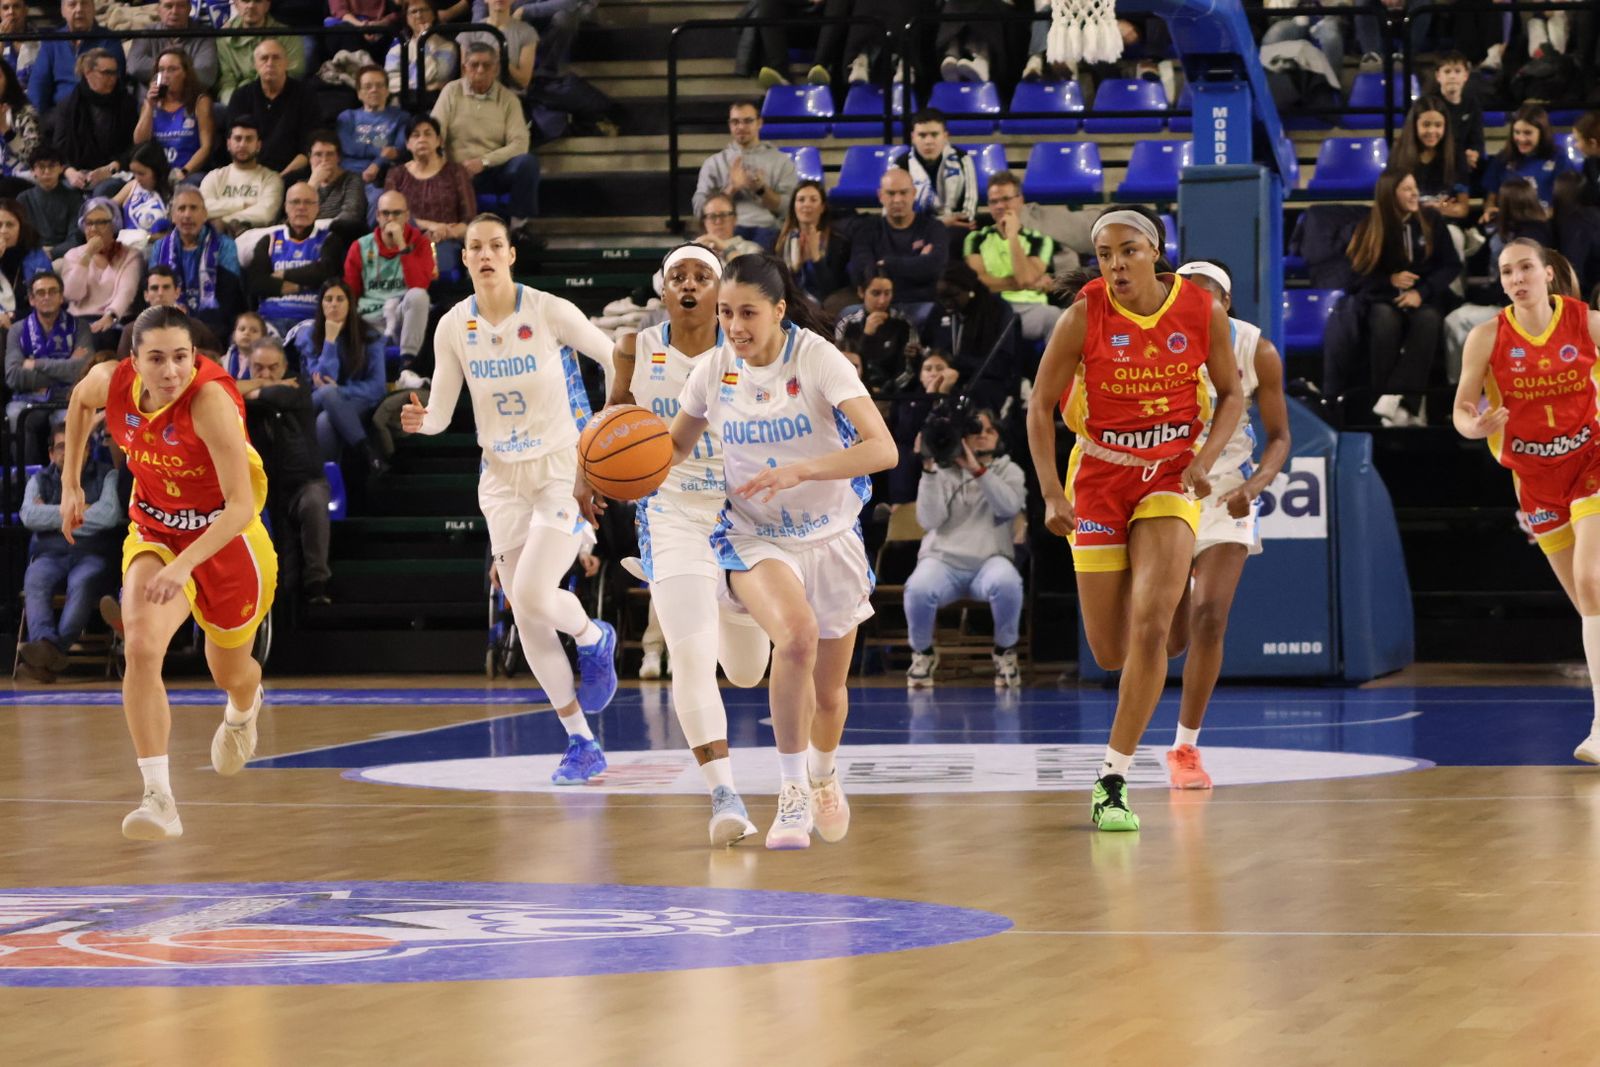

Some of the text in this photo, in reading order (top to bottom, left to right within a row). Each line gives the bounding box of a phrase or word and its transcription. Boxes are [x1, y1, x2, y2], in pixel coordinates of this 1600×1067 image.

[1213, 107, 1228, 165] MONDO
[602, 250, 621, 258] FILA
[566, 278, 593, 286] FILA 4
[469, 354, 537, 379] AVENIDA
[1114, 362, 1188, 380] QUALCO
[1513, 369, 1578, 388] QUALCO
[492, 390, 527, 416] 23
[1138, 396, 1170, 418] 33
[1543, 405, 1555, 428] 1
[723, 413, 813, 445] AVENIDA
[1511, 426, 1591, 456] novibet
[445, 521, 474, 530] FILA 1
[1263, 641, 1322, 655] MONDO
